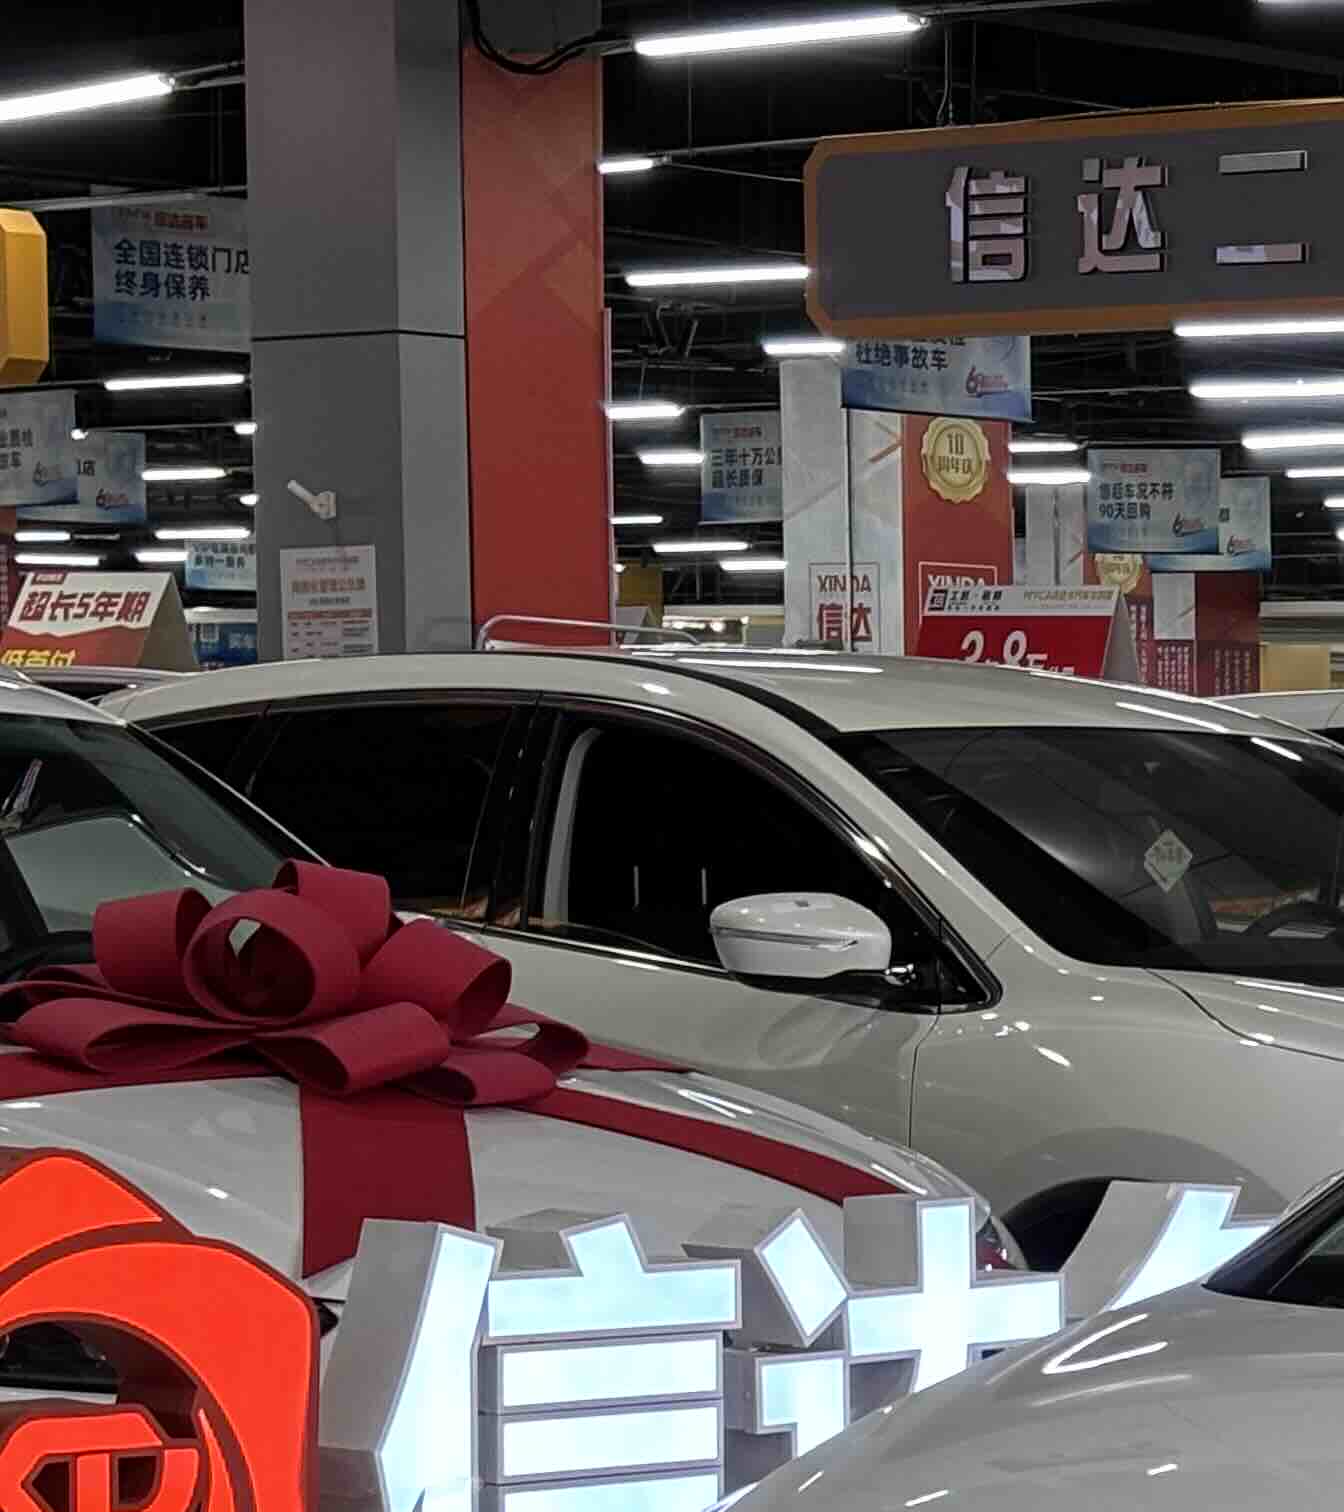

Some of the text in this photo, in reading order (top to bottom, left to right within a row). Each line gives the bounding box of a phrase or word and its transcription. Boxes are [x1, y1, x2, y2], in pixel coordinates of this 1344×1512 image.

[114, 238, 250, 275] 全国连锁门店
[114, 269, 211, 301] 终身保养
[711, 447, 782, 466] 三年十万公
[19, 590, 151, 623] 超长5年期
